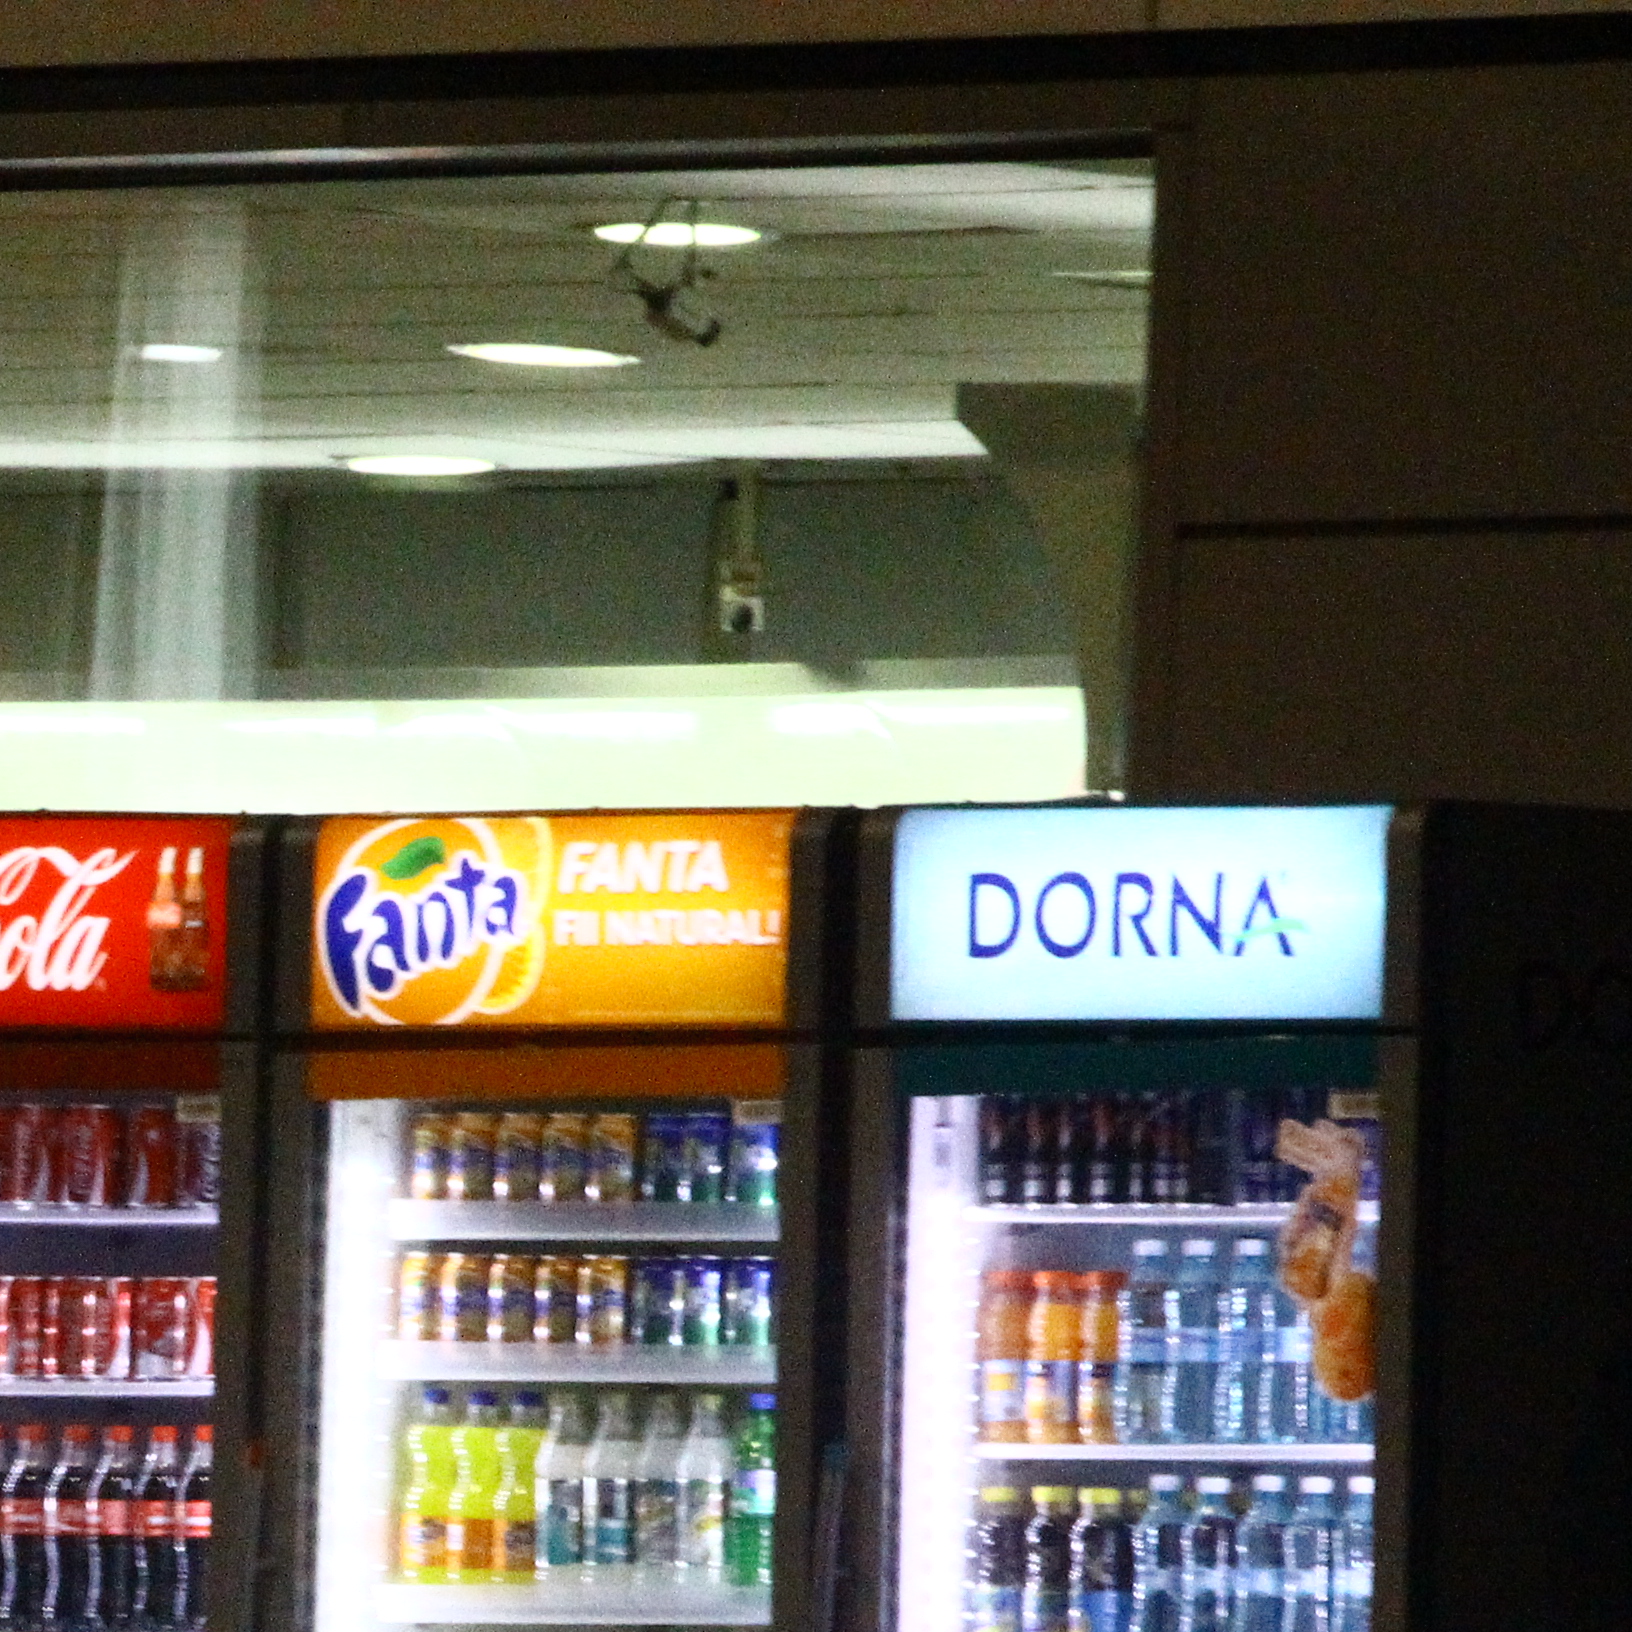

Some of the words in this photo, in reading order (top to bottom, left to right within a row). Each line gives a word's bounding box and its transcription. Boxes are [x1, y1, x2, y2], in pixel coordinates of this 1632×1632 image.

[557, 840, 730, 893] FANTA
[321, 853, 524, 1014] Fanta
[605, 909, 782, 946] NATURAL!
[967, 871, 1297, 959] DORNA
